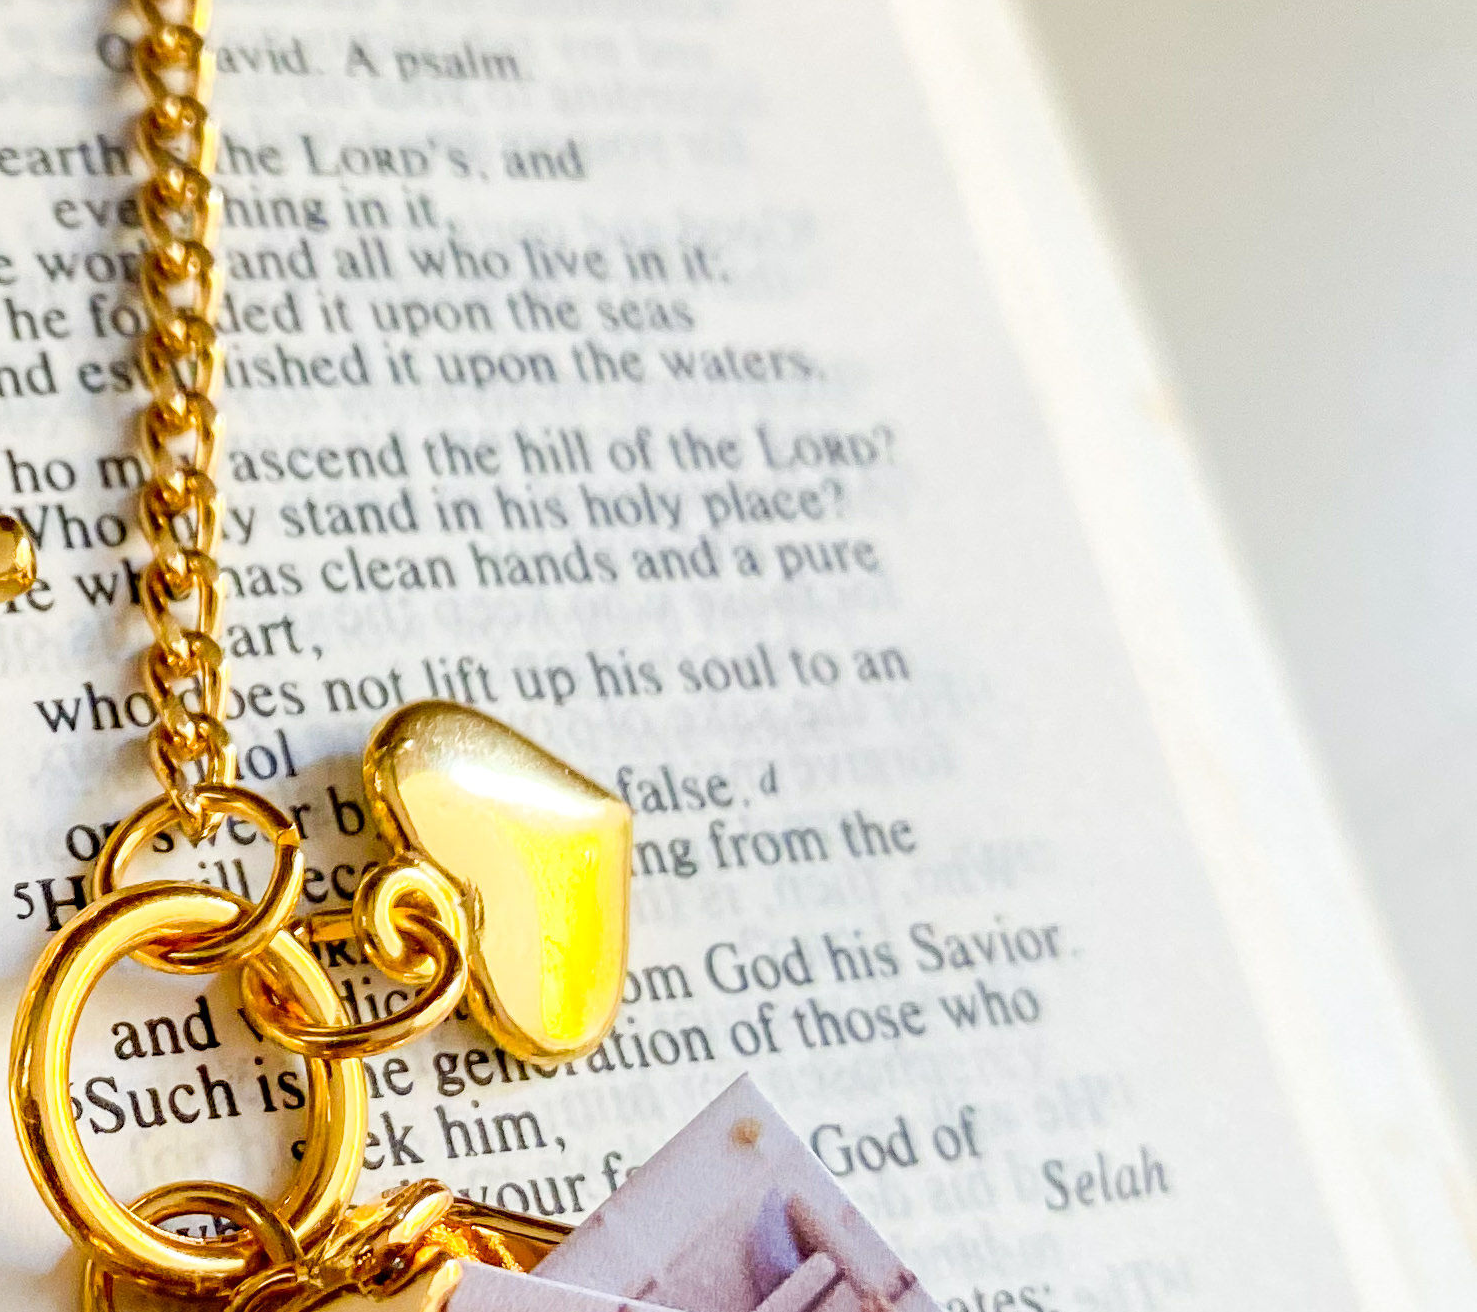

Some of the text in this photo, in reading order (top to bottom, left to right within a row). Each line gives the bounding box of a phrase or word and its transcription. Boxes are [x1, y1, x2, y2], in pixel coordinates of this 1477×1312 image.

[705, 938, 814, 993] God
[115, 996, 220, 1061] and
[258, 1056, 305, 1113] is
[731, 1002, 779, 1056] of
[437, 1101, 566, 1159] him,
